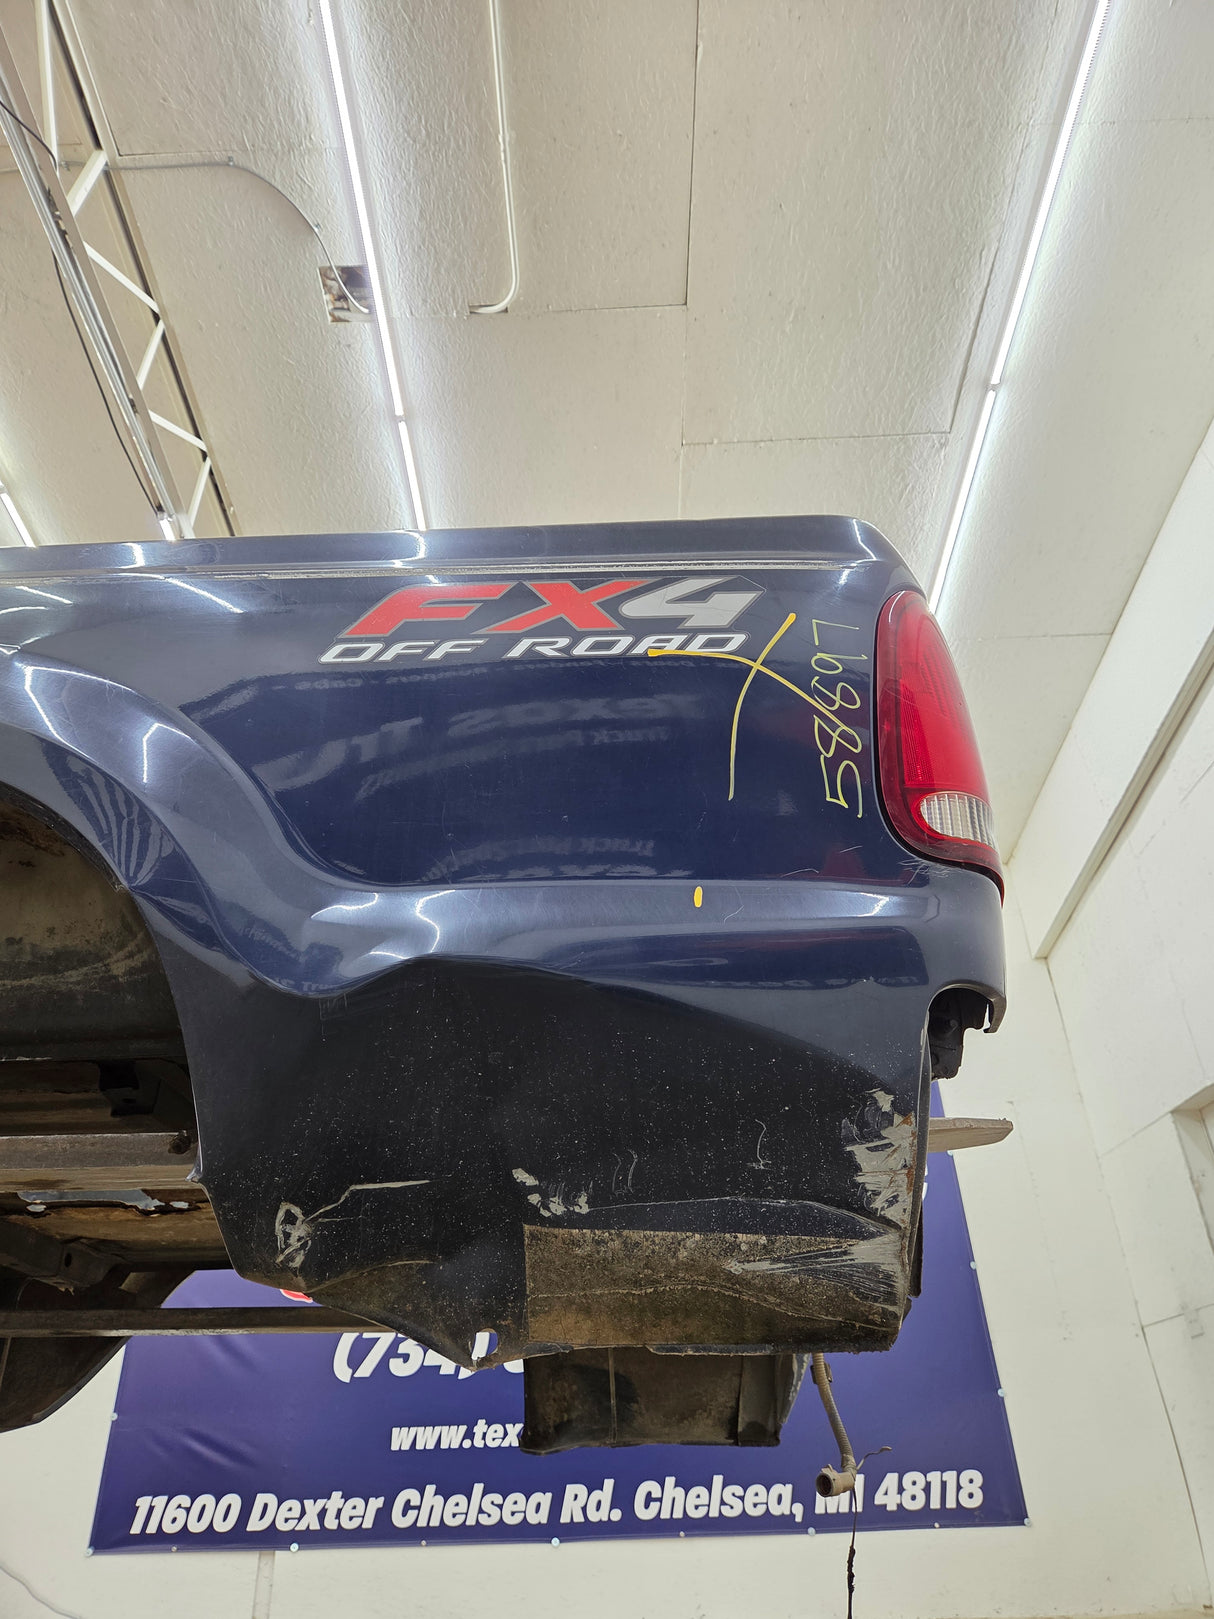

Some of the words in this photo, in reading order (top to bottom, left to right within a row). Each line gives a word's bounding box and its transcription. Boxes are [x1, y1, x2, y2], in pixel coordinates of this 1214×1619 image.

[338, 577, 764, 638] FX4
[320, 637, 488, 664] OFF
[503, 633, 748, 659] ROAD
[390, 1419, 524, 1451] www.tex
[130, 1493, 242, 1535] 11600
[246, 1490, 384, 1532] Dexter
[391, 1483, 552, 1527] Chelsea
[559, 1479, 622, 1524] Rd.
[633, 1474, 804, 1522] Chelsea,
[874, 1469, 984, 1511] 48118
